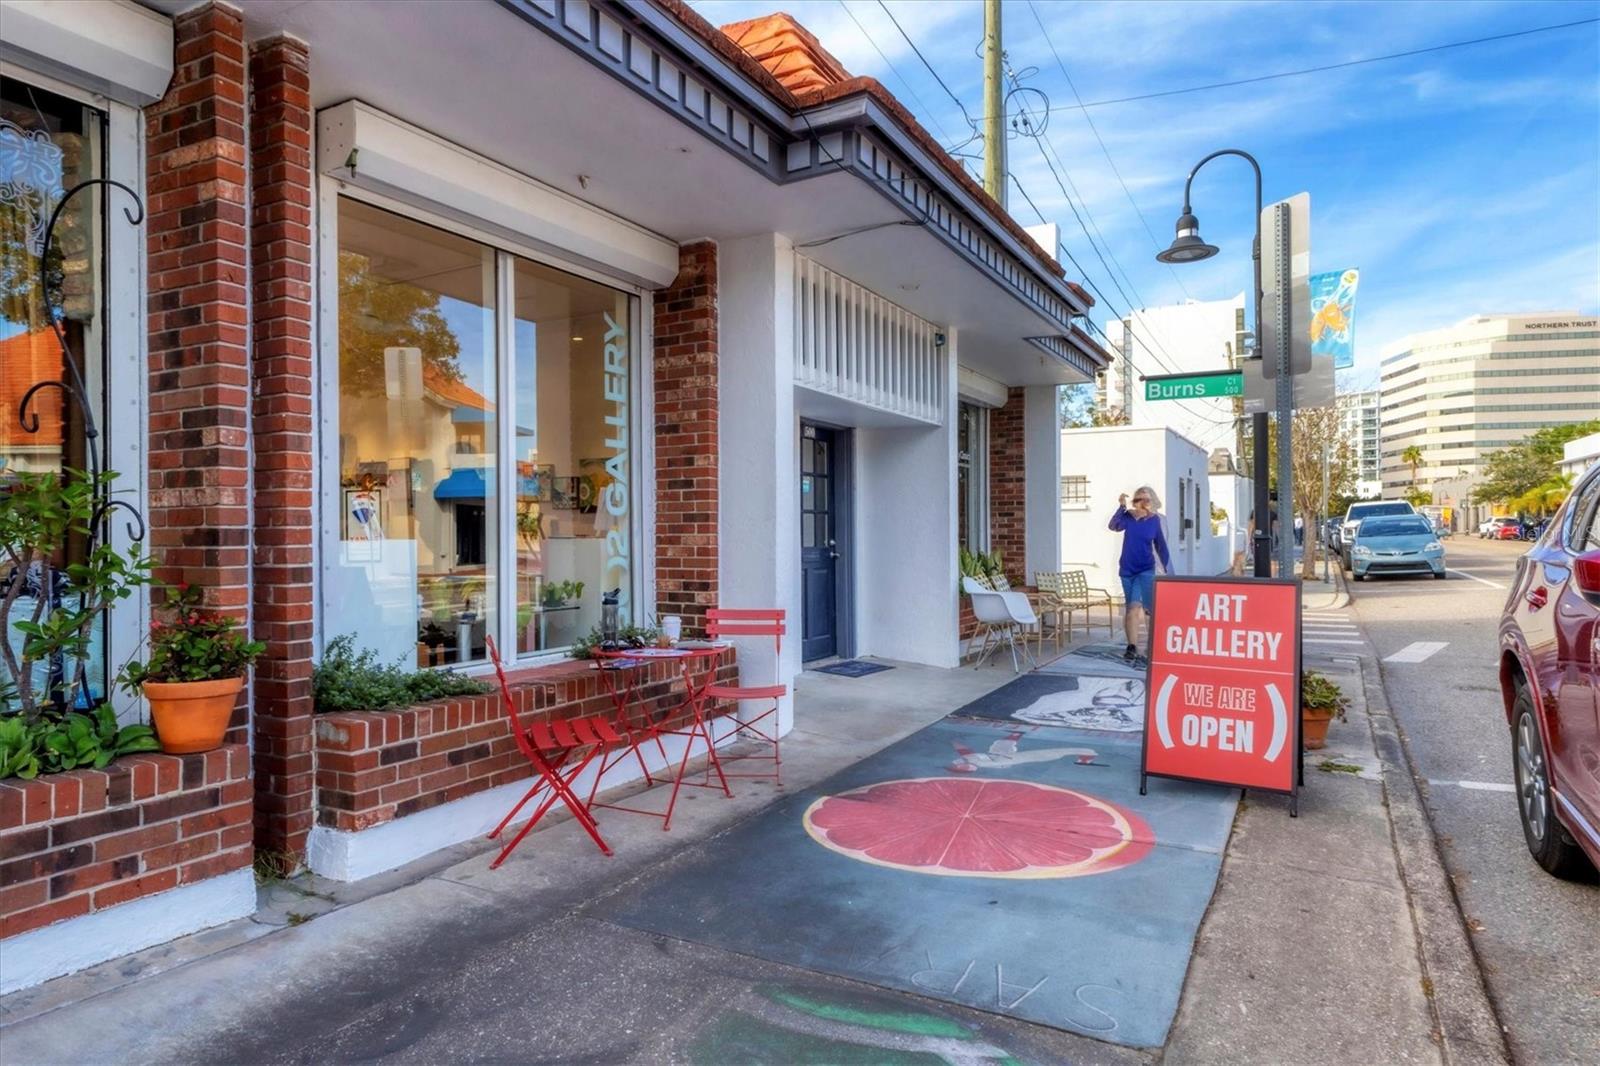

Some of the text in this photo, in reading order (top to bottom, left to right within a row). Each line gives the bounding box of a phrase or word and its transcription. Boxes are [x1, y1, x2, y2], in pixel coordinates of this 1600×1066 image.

[1525, 320, 1597, 329] NORTHERN TRUST
[1148, 382, 1206, 398] Burns
[603, 311, 629, 517] GALLERY
[1195, 594, 1247, 622] ART
[1166, 625, 1283, 661] GALLERY
[1183, 682, 1256, 712] WE ARE
[1181, 714, 1254, 754] OPEN
